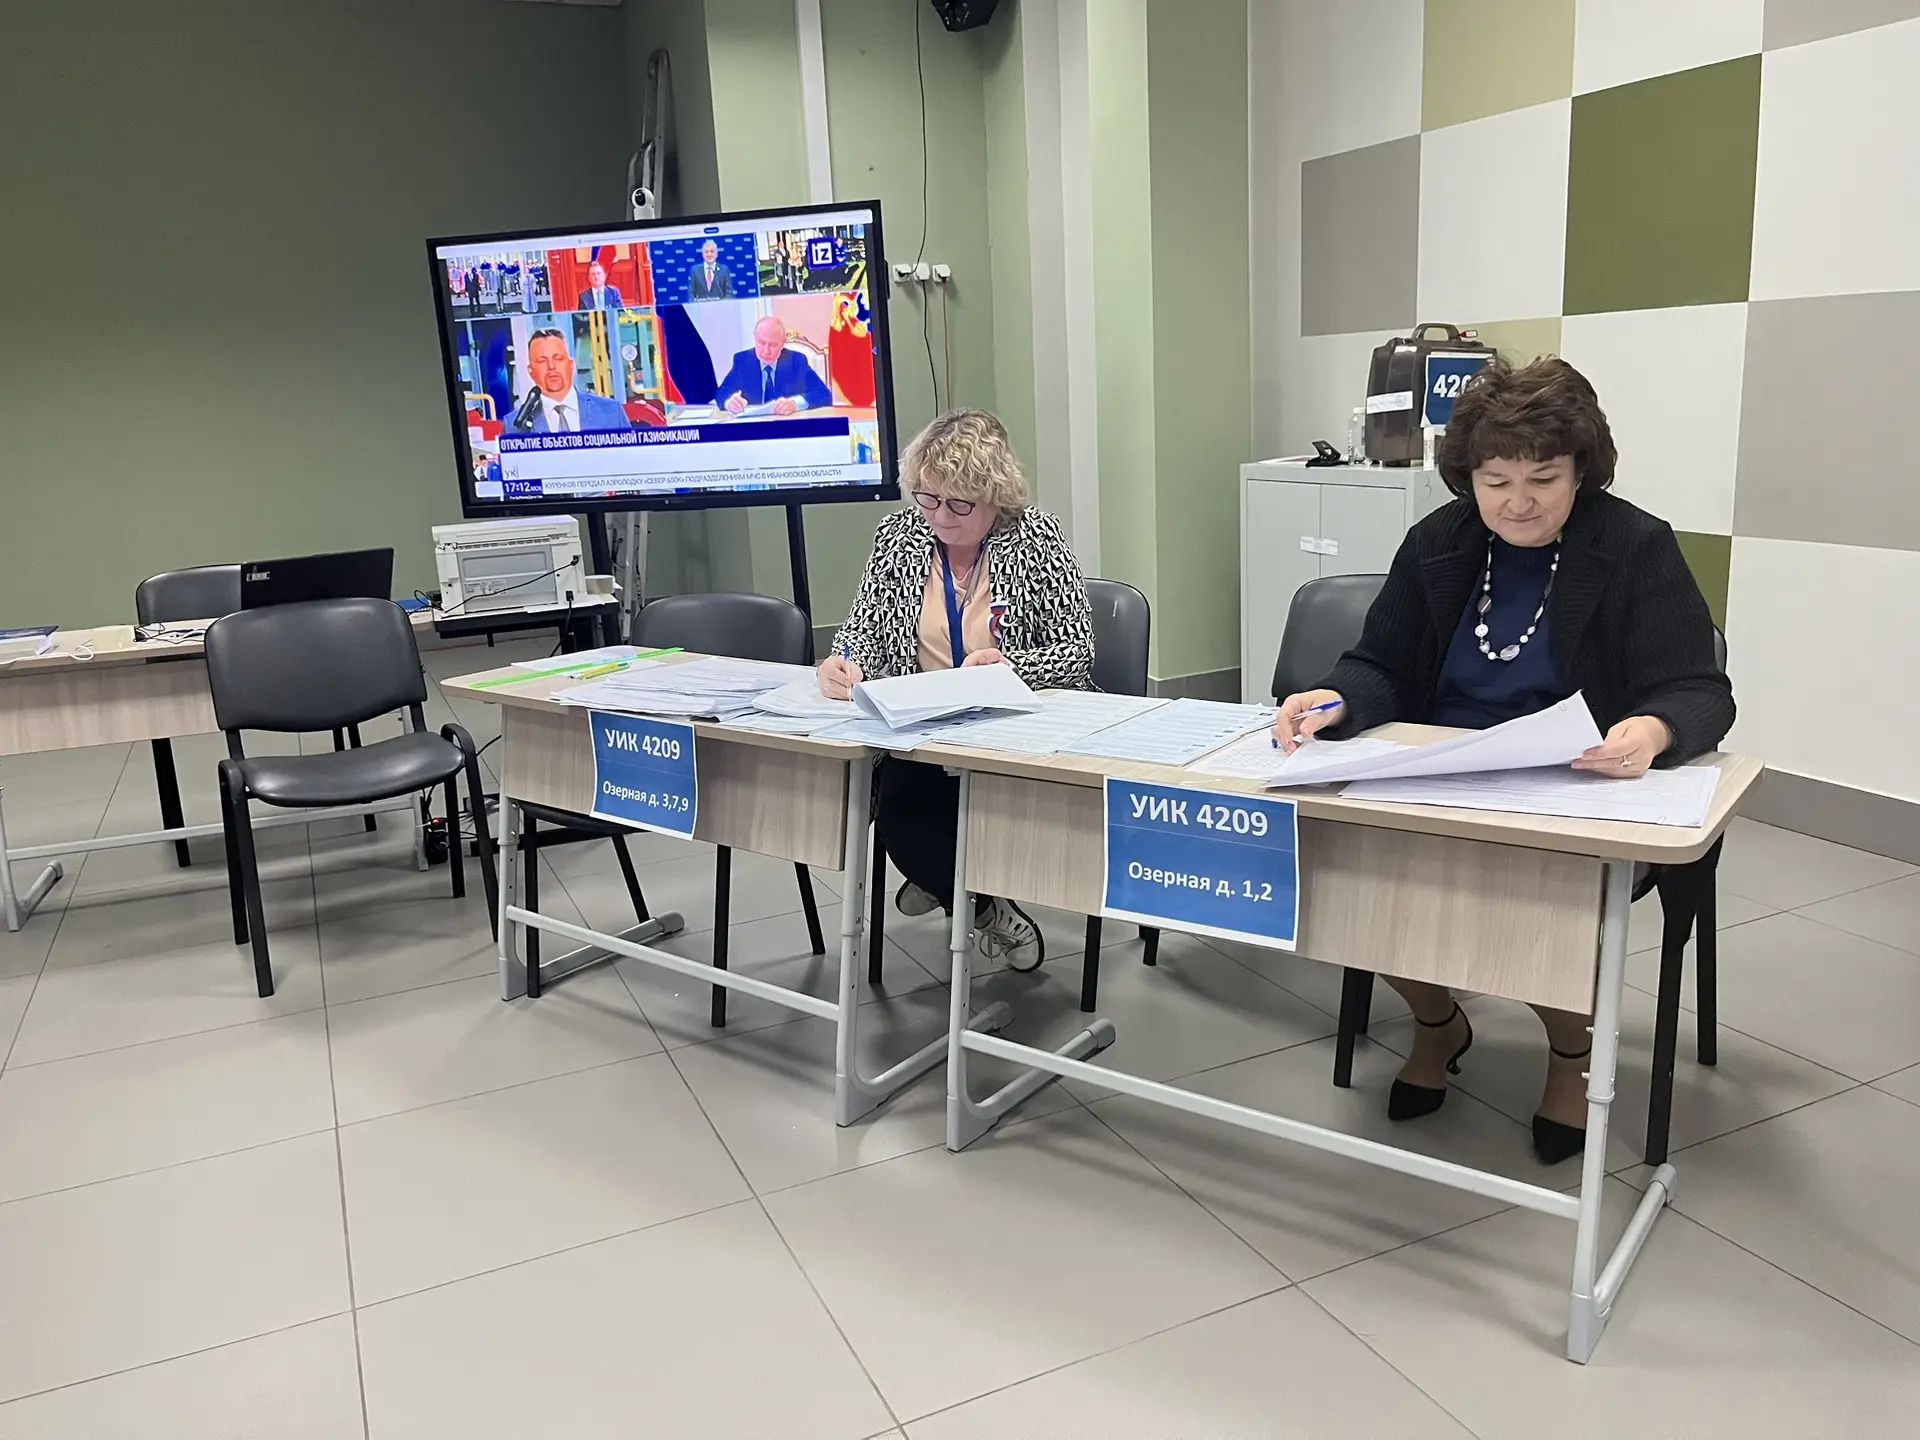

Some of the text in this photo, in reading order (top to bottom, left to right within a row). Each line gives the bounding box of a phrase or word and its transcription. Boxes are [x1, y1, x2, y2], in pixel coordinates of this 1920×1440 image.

[500, 429, 700, 451] ОТКРЫТИЕ ОБЪЕКТОВ СОЦИАЛЬНОЙ ГАЗИФИКАЦИИ
[504, 482, 530, 493] 17:12
[604, 728, 680, 760] УИК 4209
[602, 780, 689, 812] Озерная д. 3,7,9
[1129, 793, 1268, 837] УИК 4209
[1128, 861, 1273, 903] Озерная д. 1,2
